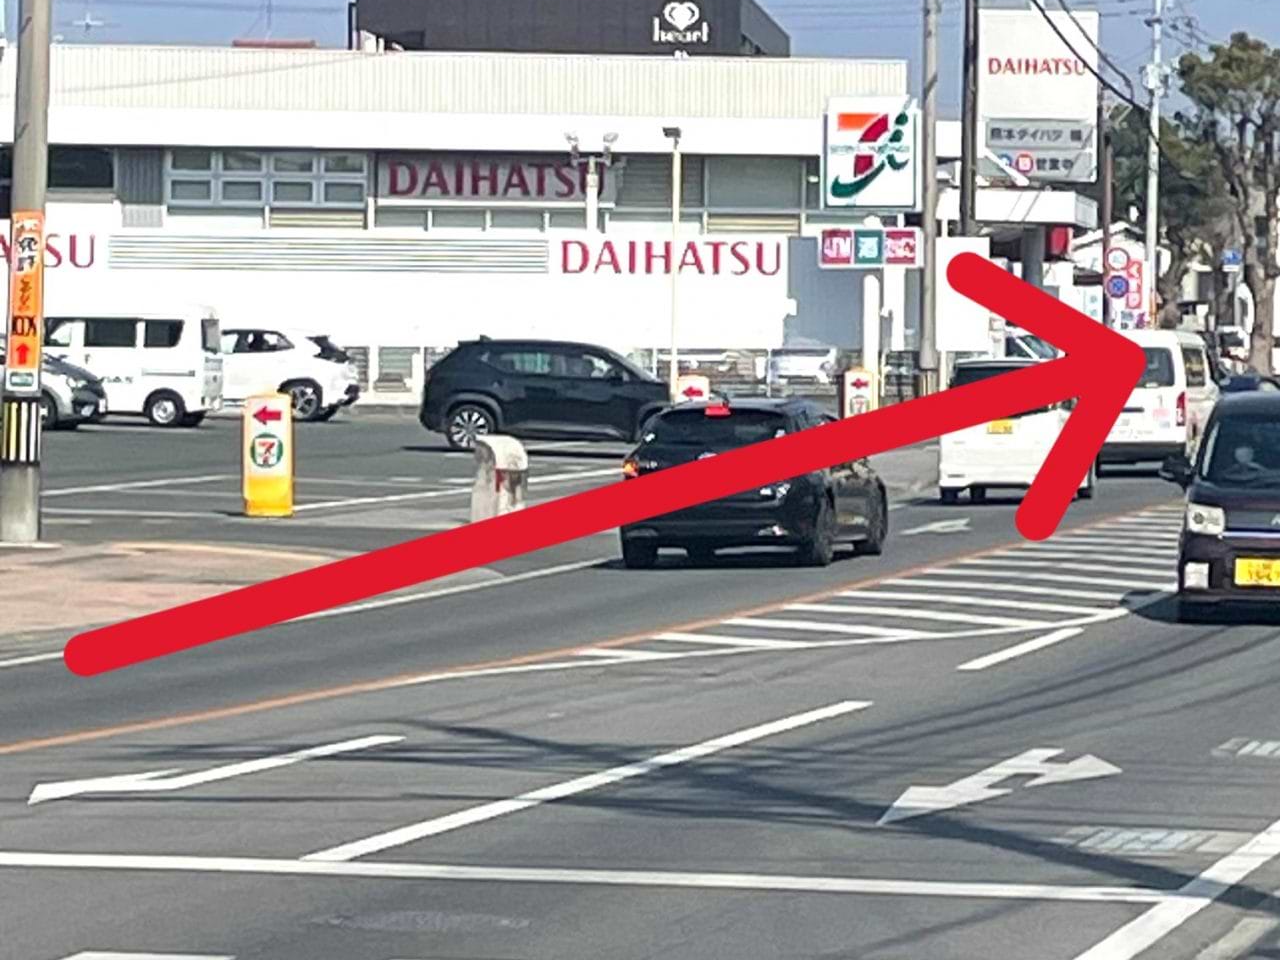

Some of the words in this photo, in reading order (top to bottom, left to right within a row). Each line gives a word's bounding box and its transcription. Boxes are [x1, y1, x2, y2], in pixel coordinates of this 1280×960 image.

[652, 15, 709, 43] heart
[988, 57, 1086, 76] DAIHATSU
[388, 160, 607, 197] DAIHATSU
[561, 240, 781, 275] DAIHATSU
